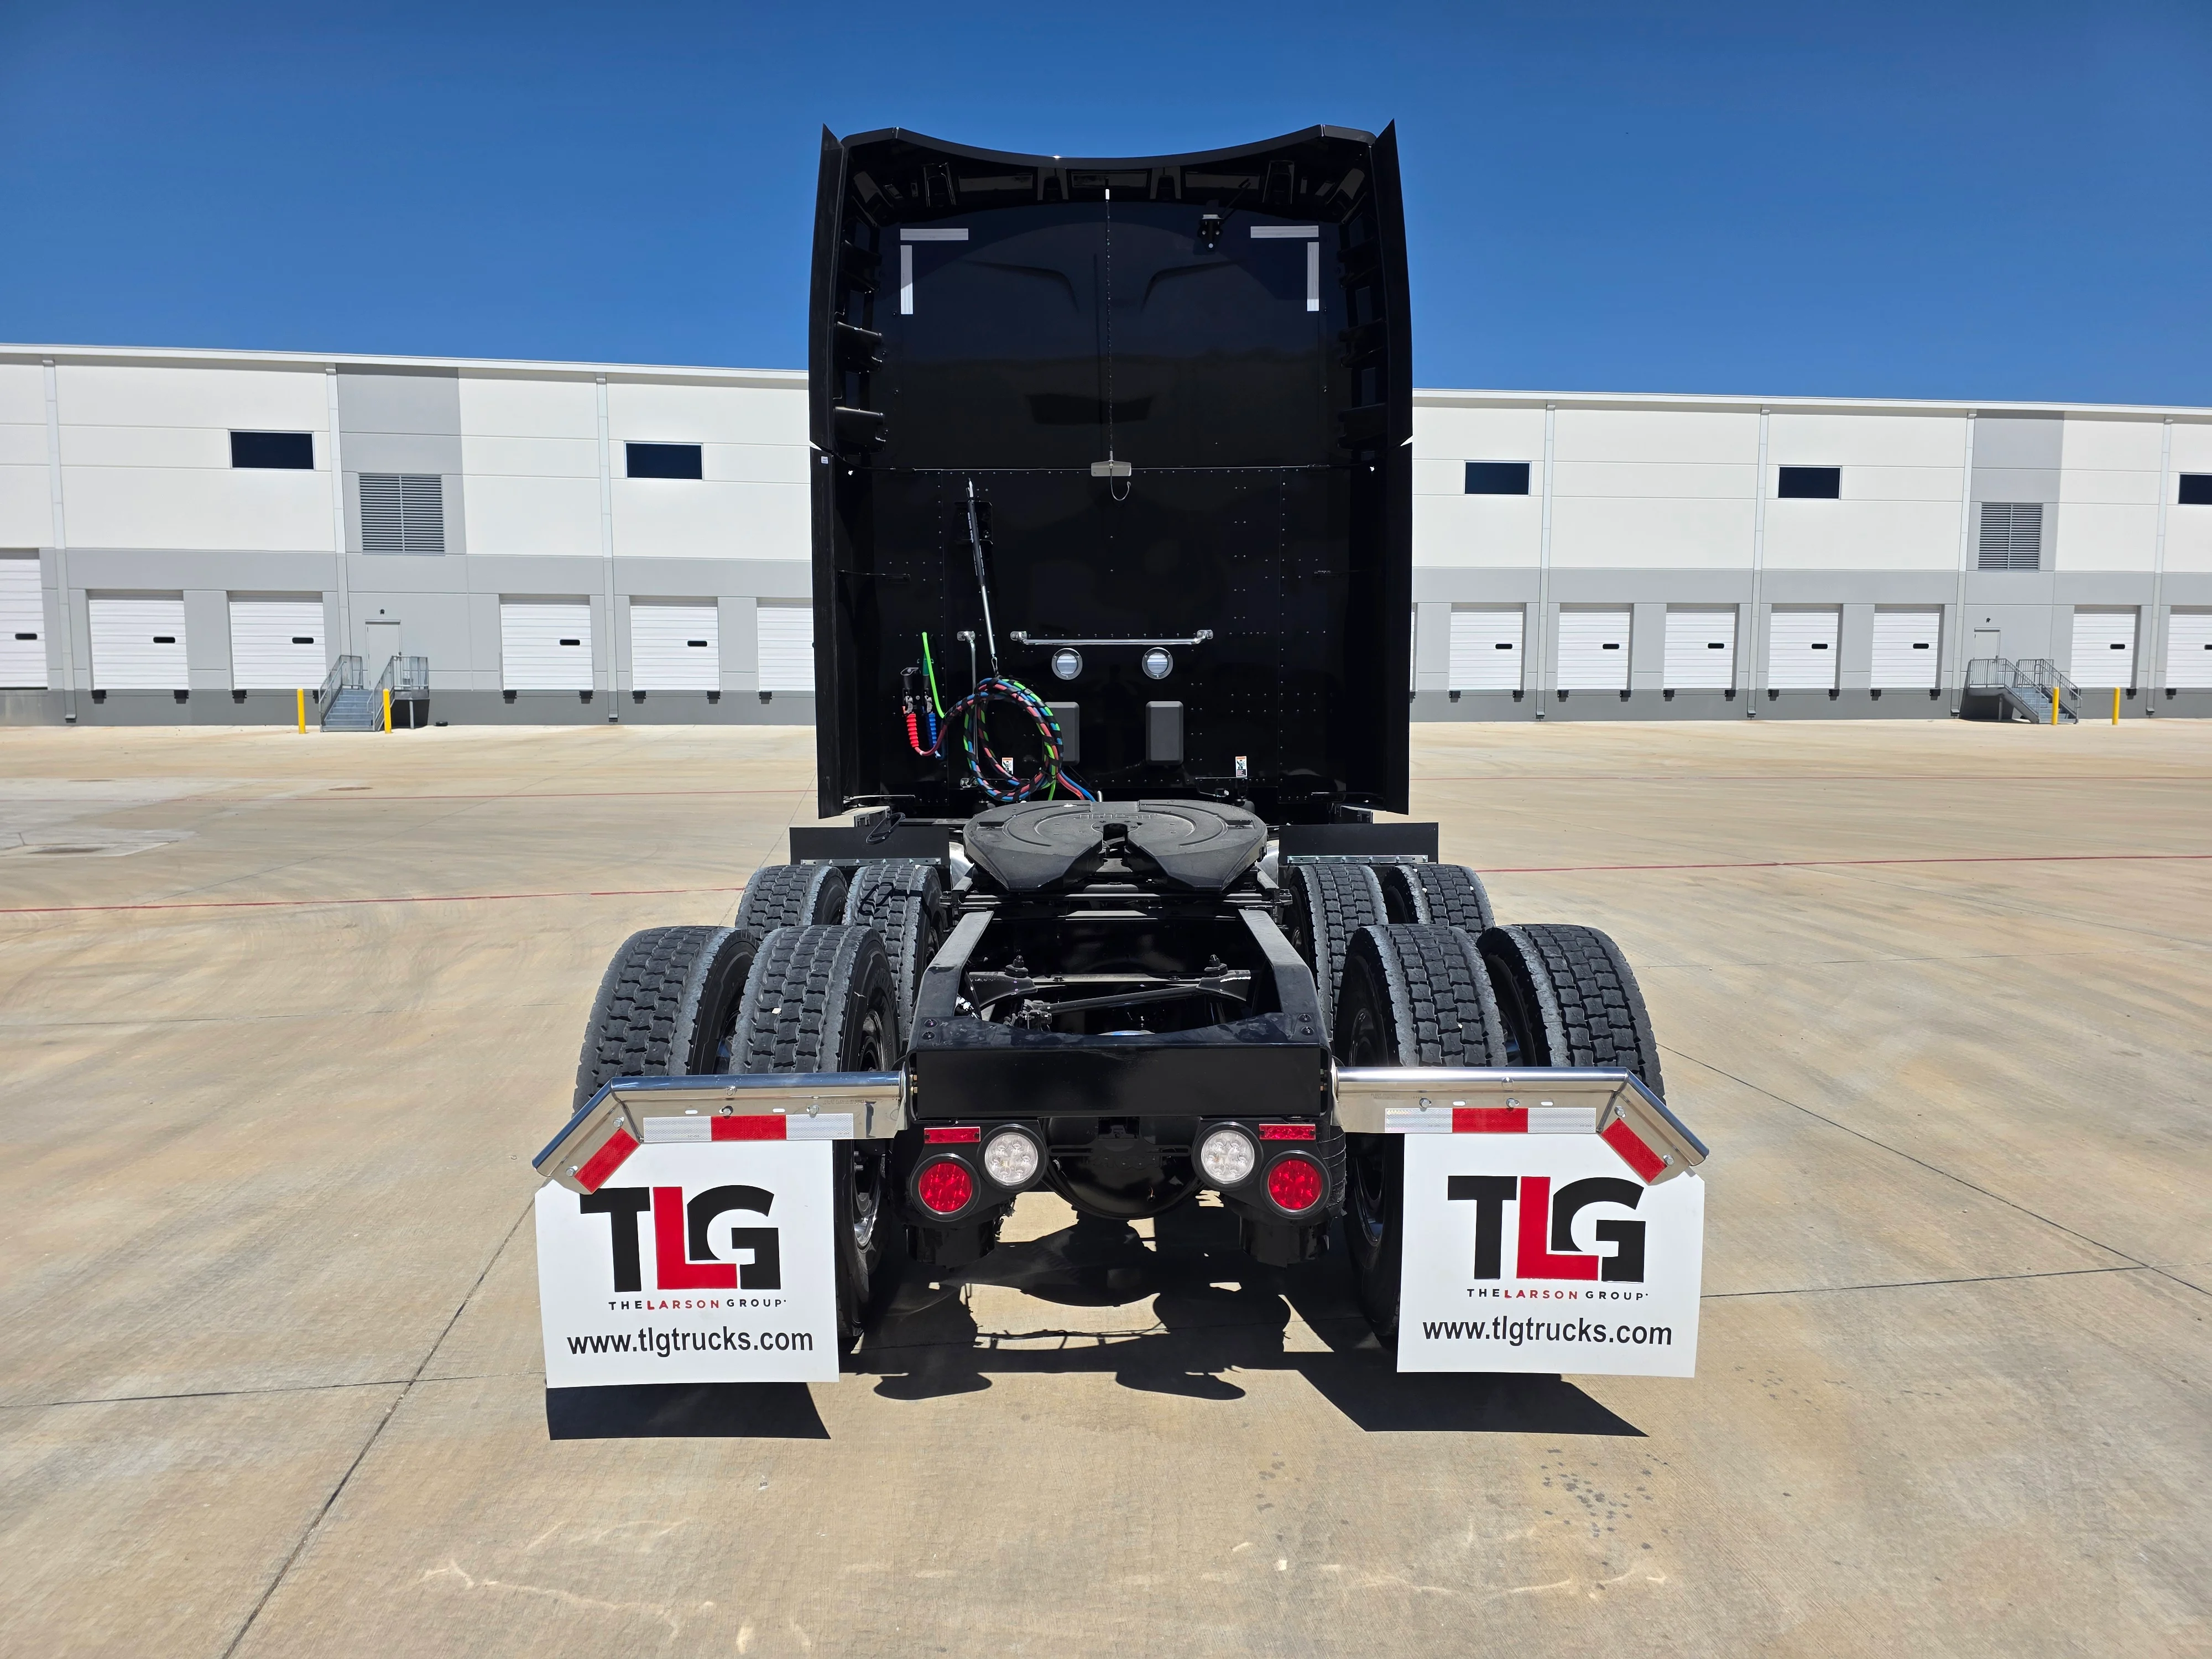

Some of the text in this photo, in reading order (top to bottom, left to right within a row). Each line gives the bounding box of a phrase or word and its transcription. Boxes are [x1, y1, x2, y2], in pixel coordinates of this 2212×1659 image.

[580, 1185, 781, 1292] TLG
[1447, 1175, 1646, 1284] TLG
[726, 1298, 782, 1307] GROUP
[1585, 1291, 1644, 1301] GROUP
[566, 1326, 813, 1358] www.tlgtrucks.com
[1422, 1315, 1672, 1347] www.tlgtrucks.com
